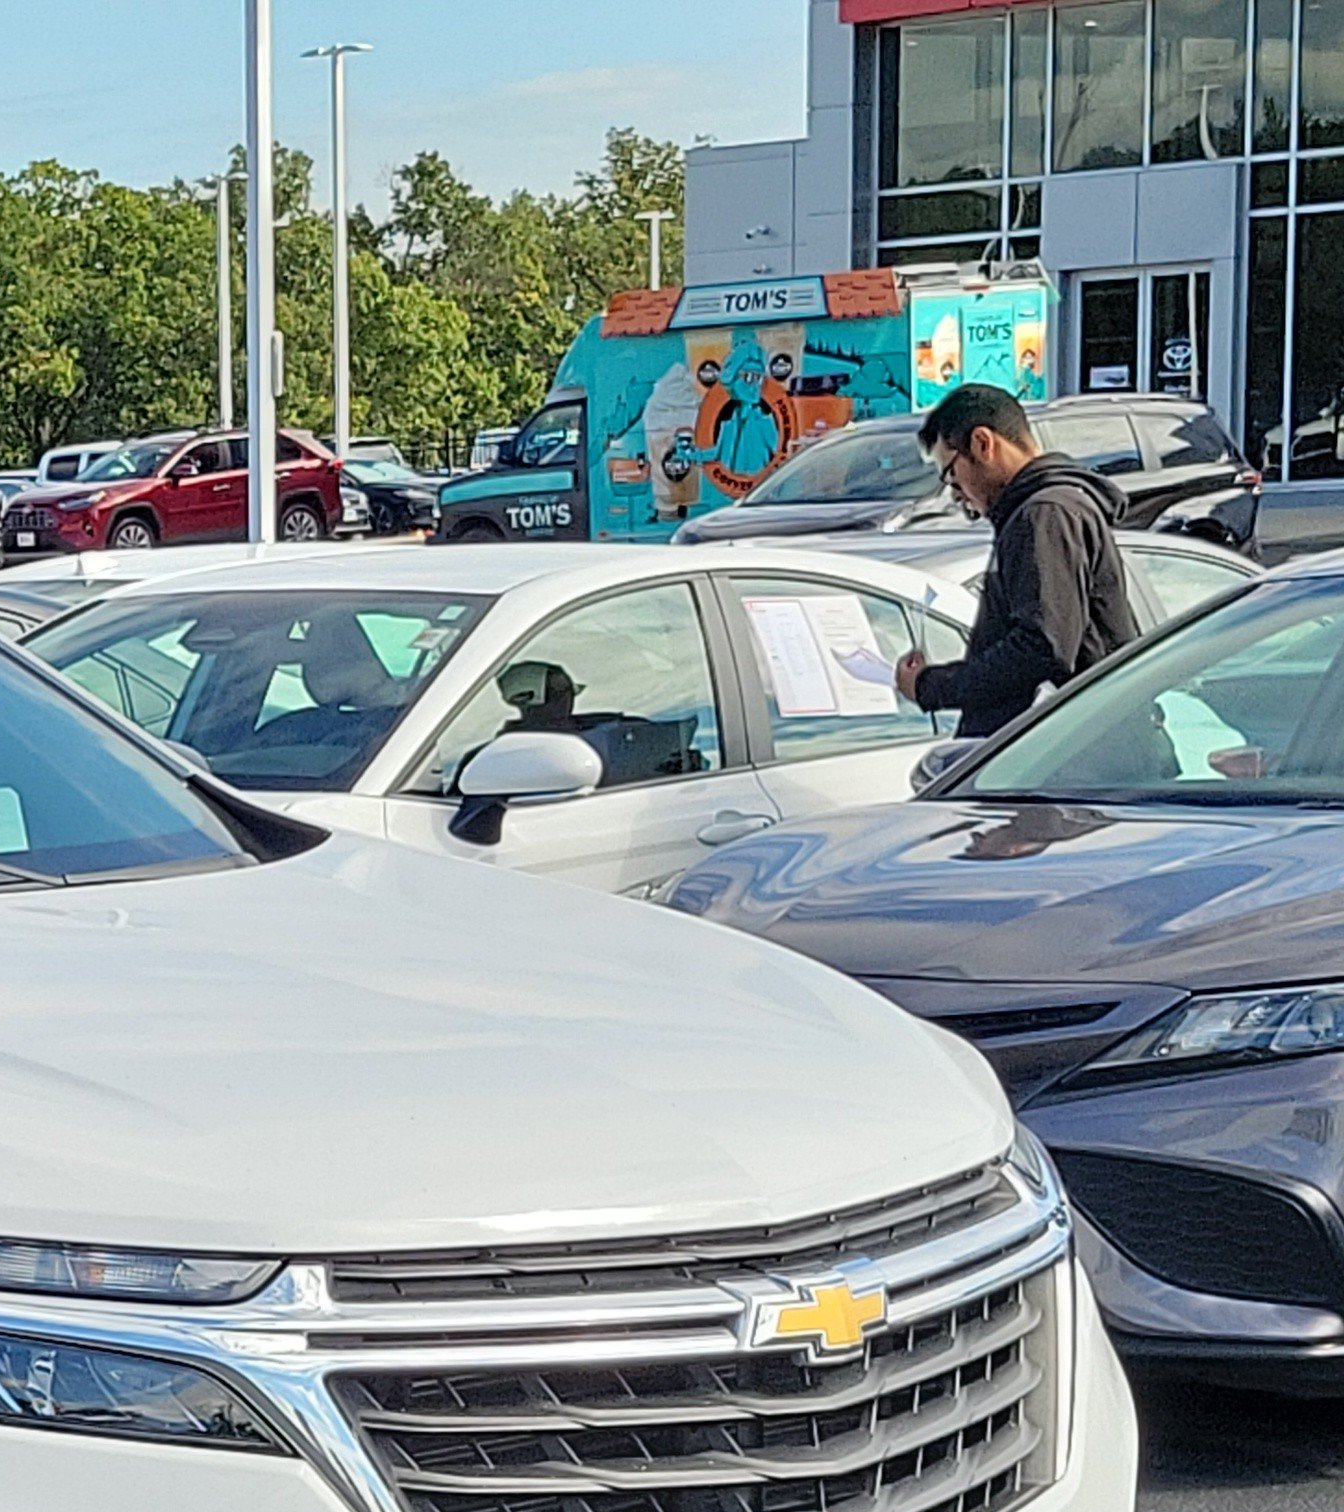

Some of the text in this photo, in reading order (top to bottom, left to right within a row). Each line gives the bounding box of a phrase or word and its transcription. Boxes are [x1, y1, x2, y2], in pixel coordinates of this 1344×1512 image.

[724, 289, 788, 312] TOM'S
[967, 322, 1012, 343] TOM'S
[505, 502, 573, 529] TOM'S
